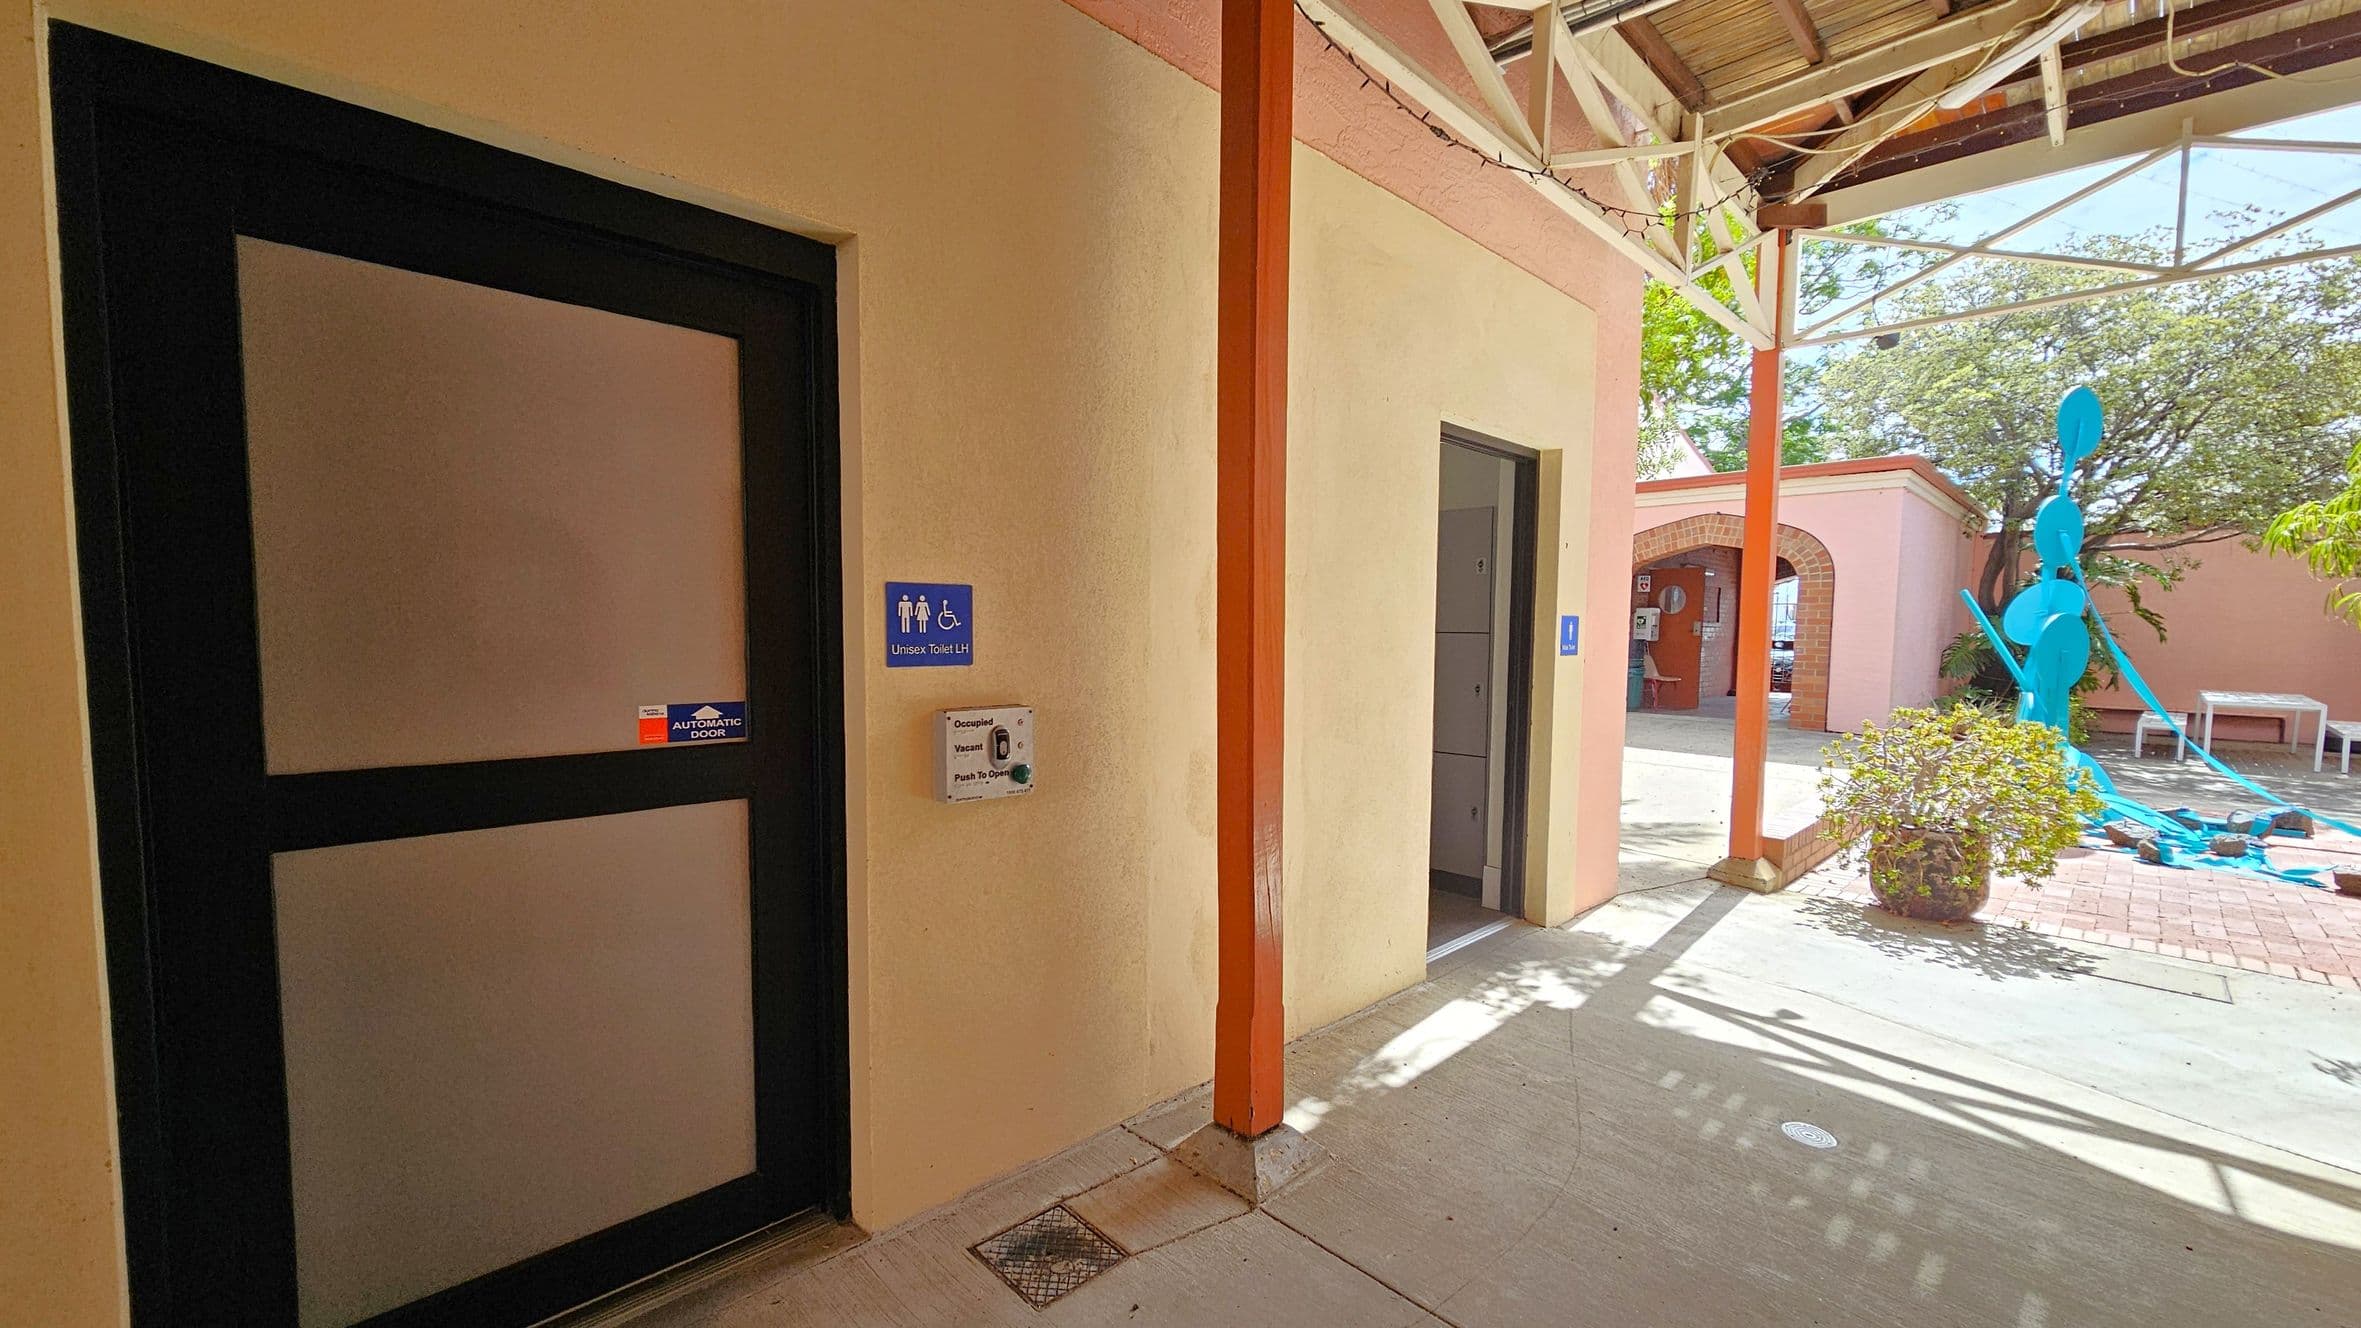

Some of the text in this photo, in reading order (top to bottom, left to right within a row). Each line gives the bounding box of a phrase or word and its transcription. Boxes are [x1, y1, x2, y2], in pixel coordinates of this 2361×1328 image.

[891, 643, 969, 655] Unisex Toilet LH
[672, 719, 742, 730] AUTOMATIC
[954, 718, 994, 729] Occupied
[690, 729, 726, 739] DOOR
[954, 743, 983, 752] Vacant
[954, 769, 1010, 782] Push To Open
